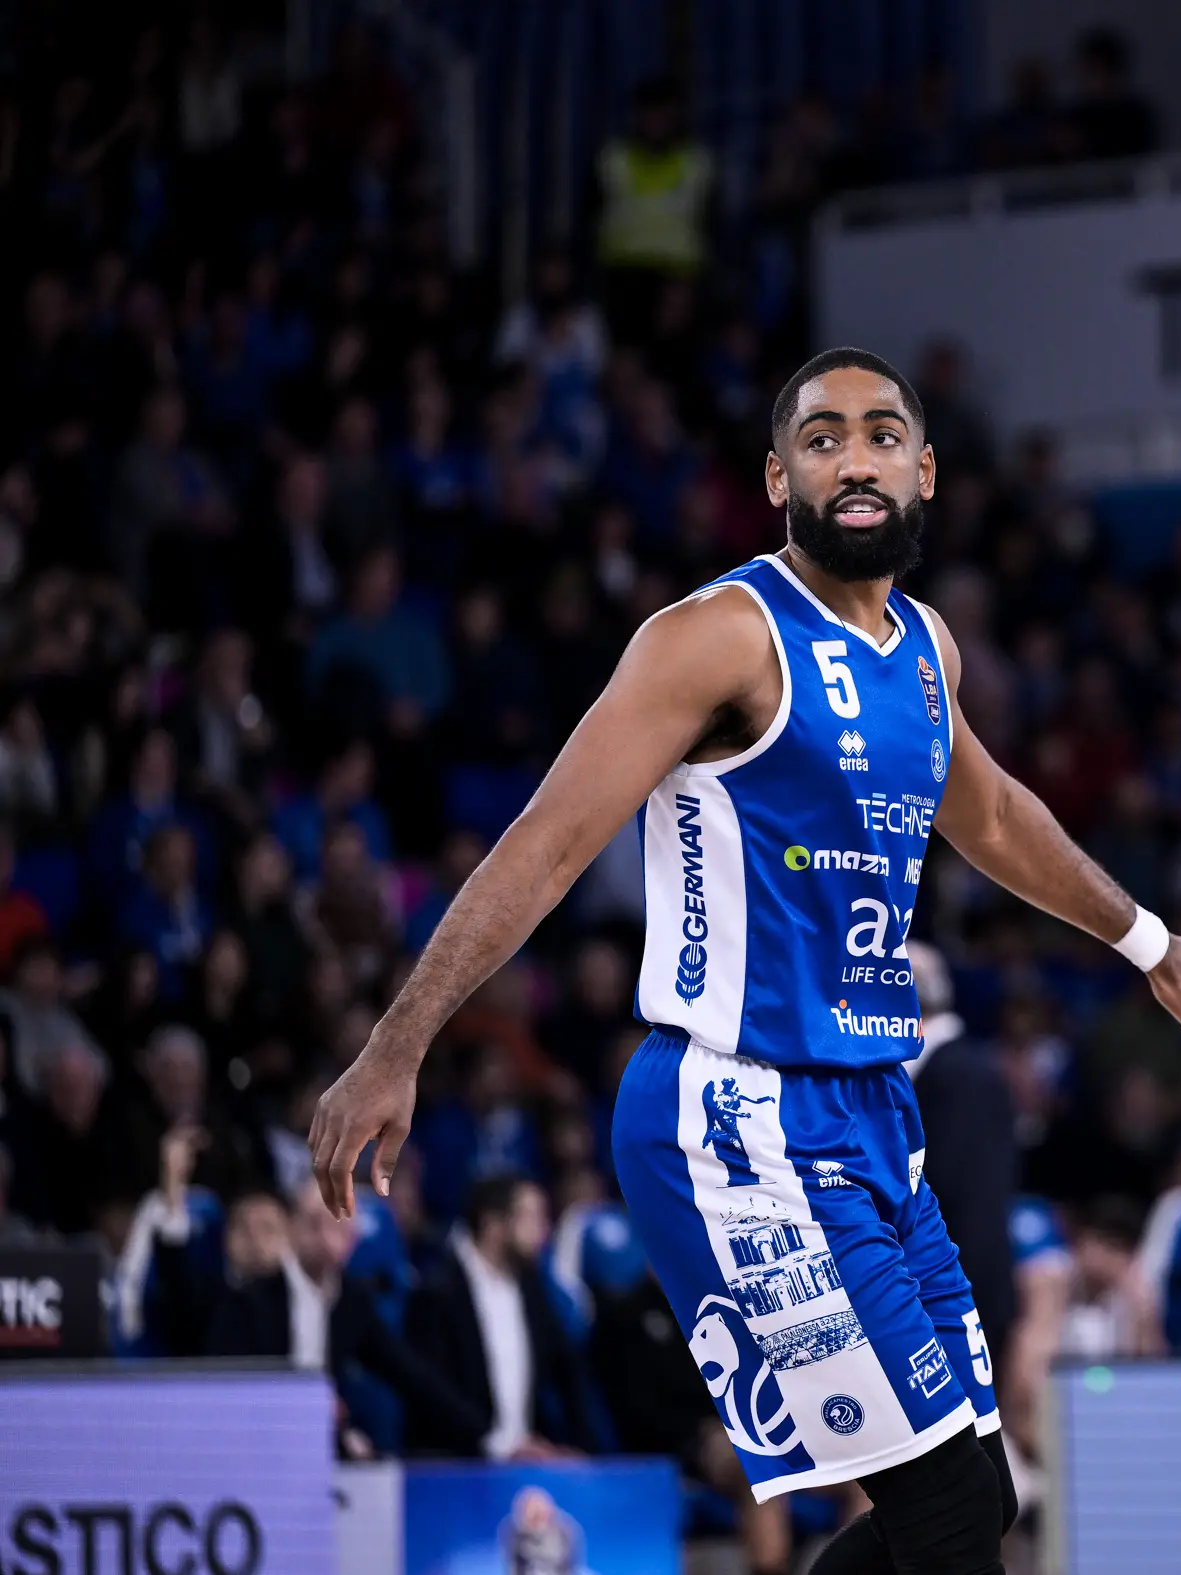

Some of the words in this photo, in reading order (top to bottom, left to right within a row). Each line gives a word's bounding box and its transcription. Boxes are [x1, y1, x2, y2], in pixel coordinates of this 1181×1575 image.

[812, 640, 861, 719] 5
[856, 792, 934, 839] TECHNE
[902, 793, 935, 807] METROLOGIA
[676, 793, 709, 943] GERMANI
[842, 966, 875, 984] LIFE
[880, 968, 914, 987] CO
[961, 1307, 993, 1387] 5
